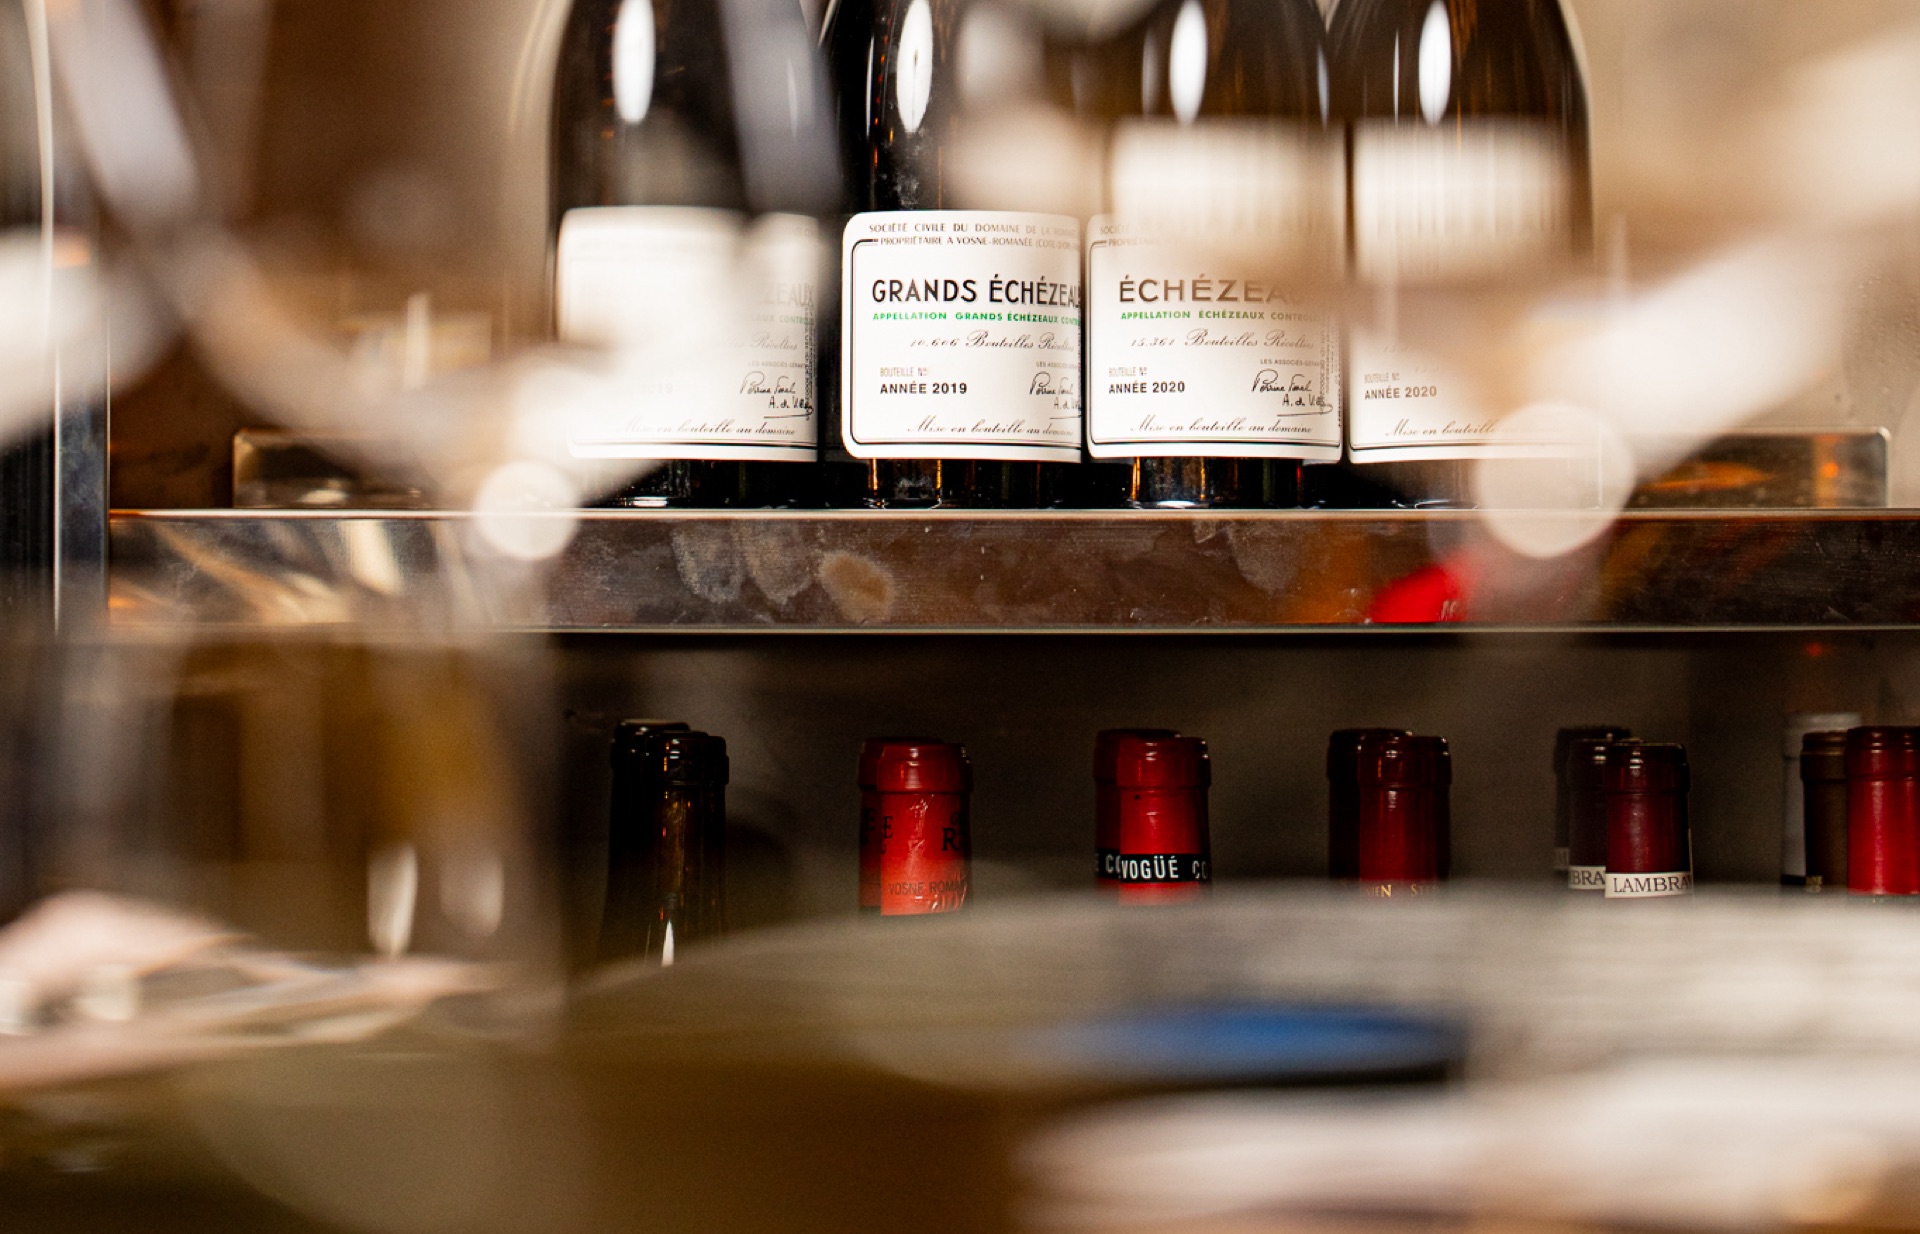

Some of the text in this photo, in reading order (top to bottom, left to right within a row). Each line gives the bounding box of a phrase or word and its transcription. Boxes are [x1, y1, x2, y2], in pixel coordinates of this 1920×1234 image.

[869, 223, 907, 233] SOCIÉTÉ
[914, 223, 947, 233] CIVILE
[953, 223, 968, 232] DU
[975, 223, 1021, 234] DOMAINE
[1025, 225, 1037, 234] DE
[880, 235, 942, 246] PROPRIÉTAIRE
[956, 237, 1033, 247] VOSNE-ROMANÉE
[872, 279, 977, 303] GRANDS
[1119, 273, 1294, 304] ÉCHÉZEA
[873, 311, 947, 321] APPELLATION
[955, 312, 1003, 322] GRANDS
[1007, 311, 1058, 323] ÉCHÉZEAUX
[1120, 310, 1191, 320] APPELLATION
[1198, 309, 1265, 320] ÉCHÉZEAUX
[965, 328, 1034, 348] Bouteilles
[1185, 328, 1258, 347] Bouteilles
[880, 366, 914, 377] BOUTEILLE
[880, 381, 968, 395] ANNÉE 2019
[1109, 380, 1186, 394] ANNÉE 2020
[1365, 385, 1437, 399] ANNÉE 2020
[677, 418, 734, 434] bouteille
[755, 421, 796, 437] domaine
[907, 415, 948, 433] Mise
[950, 425, 966, 434] en
[971, 419, 1024, 434] bouteille
[1130, 415, 1314, 434] Mise en bouteille au domaine
[1385, 419, 1420, 437] Mise
[1422, 427, 1438, 436] en
[1121, 855, 1179, 879] VOGÜÉ
[888, 882, 924, 896] VOSNE
